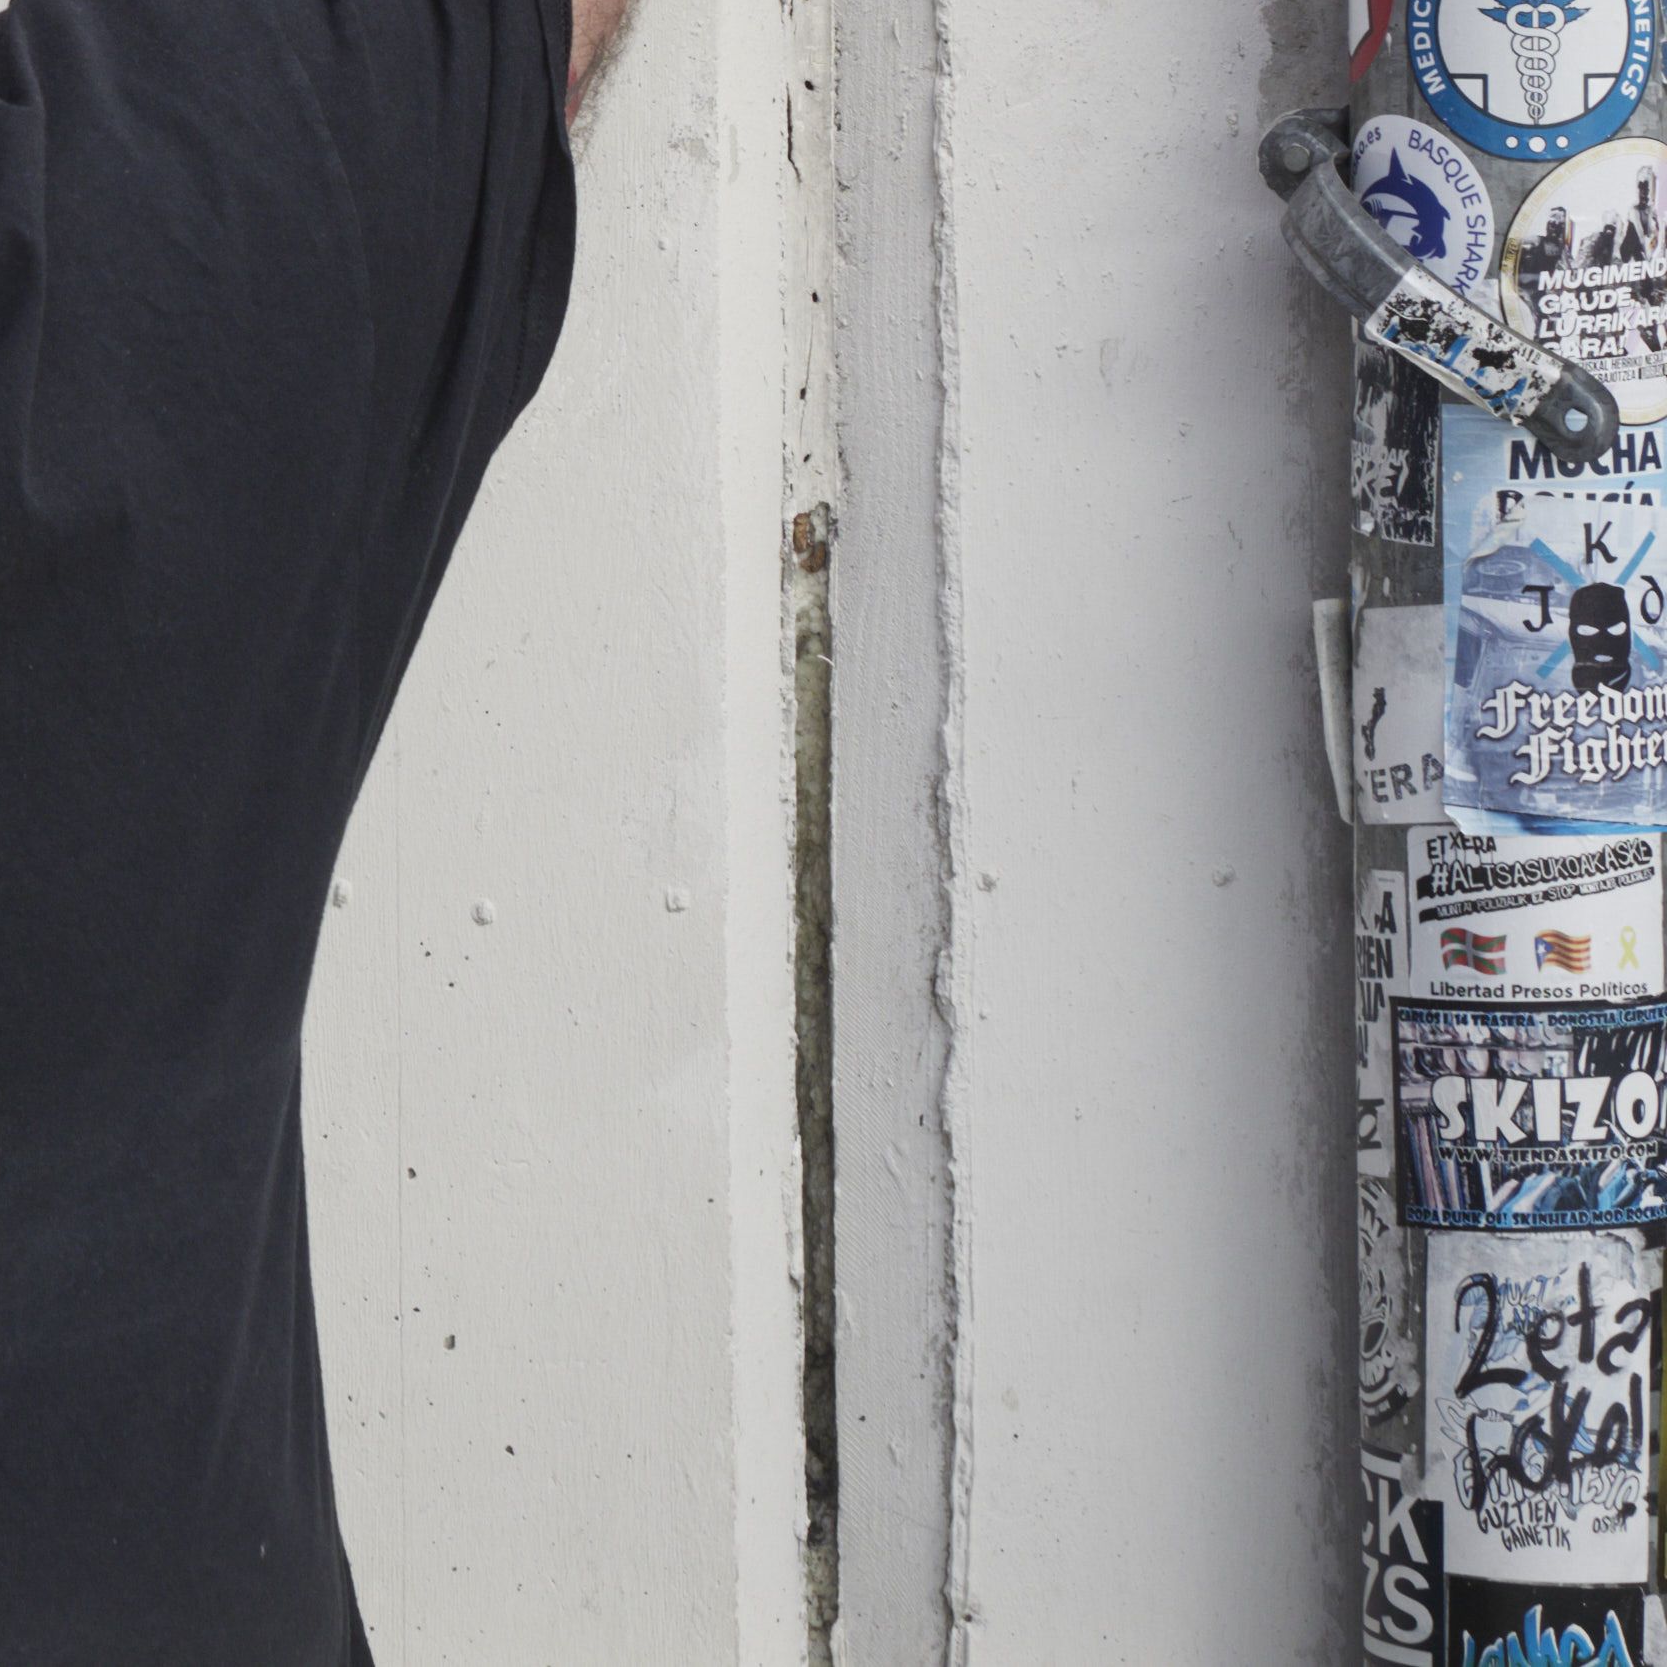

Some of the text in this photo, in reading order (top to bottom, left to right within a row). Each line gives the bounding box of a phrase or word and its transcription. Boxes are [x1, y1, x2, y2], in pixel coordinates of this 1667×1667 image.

[1407, 128, 1488, 297] BASQUE SHARK
[1583, 521, 1618, 565] K
[1522, 584, 1557, 634] J
[1426, 831, 1497, 860] ETXERA
[1548, 883, 1576, 903] STOP
[1430, 981, 1649, 999] Libertad Presos Políticos
[1471, 1011, 1536, 1027] TRASERA
[1547, 1009, 1616, 1027] DONOSTIA
[1430, 1070, 1659, 1145] SKIZO
[1441, 1209, 1483, 1225] PUNK
[1512, 1209, 1590, 1225] SKINHEAD
[1590, 1209, 1626, 1224] MOD
[1478, 1499, 1557, 1534] GUZTIEN
[1501, 1525, 1572, 1553] GAINETIK
